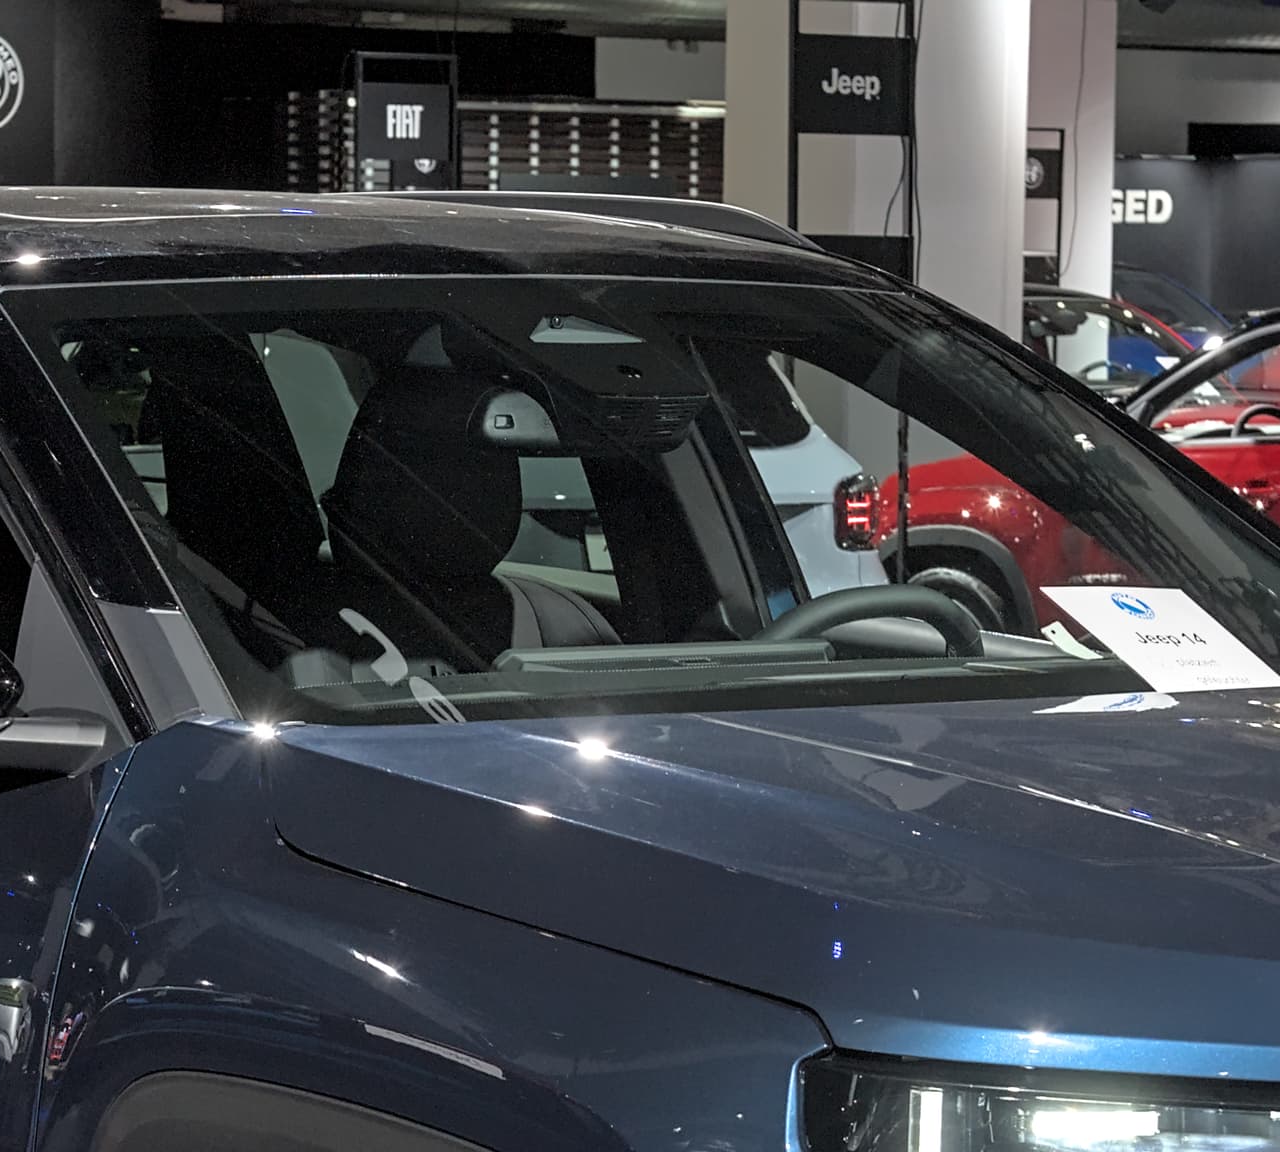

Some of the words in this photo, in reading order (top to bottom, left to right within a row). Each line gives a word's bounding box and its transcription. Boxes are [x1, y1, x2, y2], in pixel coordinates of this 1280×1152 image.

[821, 67, 881, 100] Jeep
[386, 104, 424, 139] FIAT
[1135, 631, 1181, 647] Jeep
